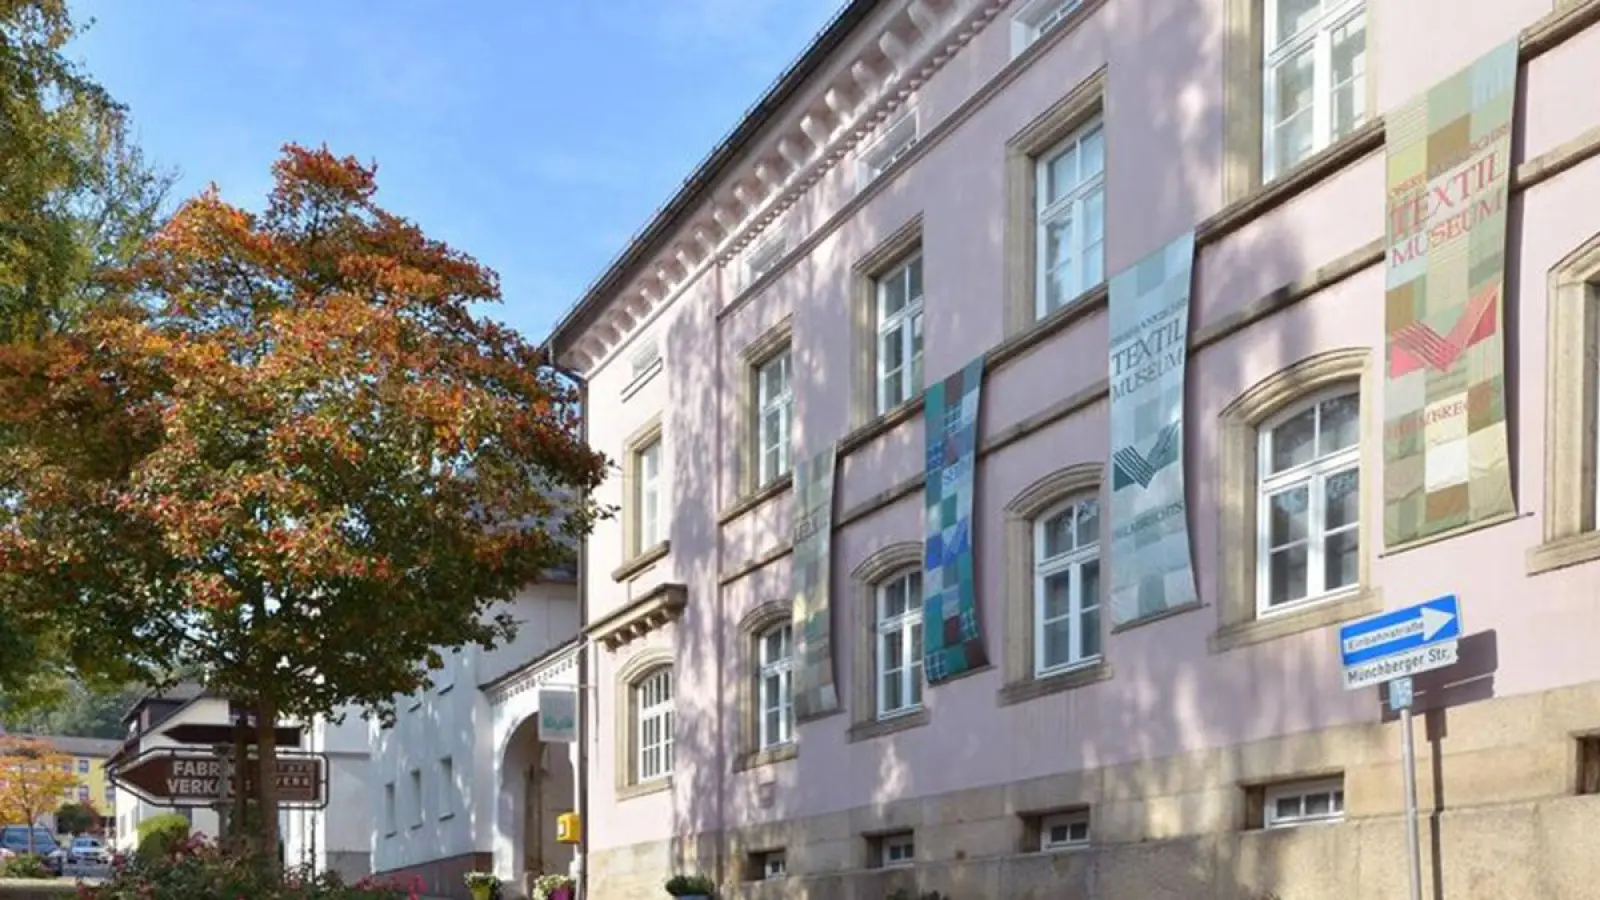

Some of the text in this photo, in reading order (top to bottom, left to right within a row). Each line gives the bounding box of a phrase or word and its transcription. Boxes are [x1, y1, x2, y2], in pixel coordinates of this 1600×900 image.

[1390, 151, 1504, 239] TEXTIL
[1391, 189, 1504, 268] MUSEUM
[1111, 318, 1185, 376] TEXTIL
[1111, 346, 1184, 403] MUSEUM
